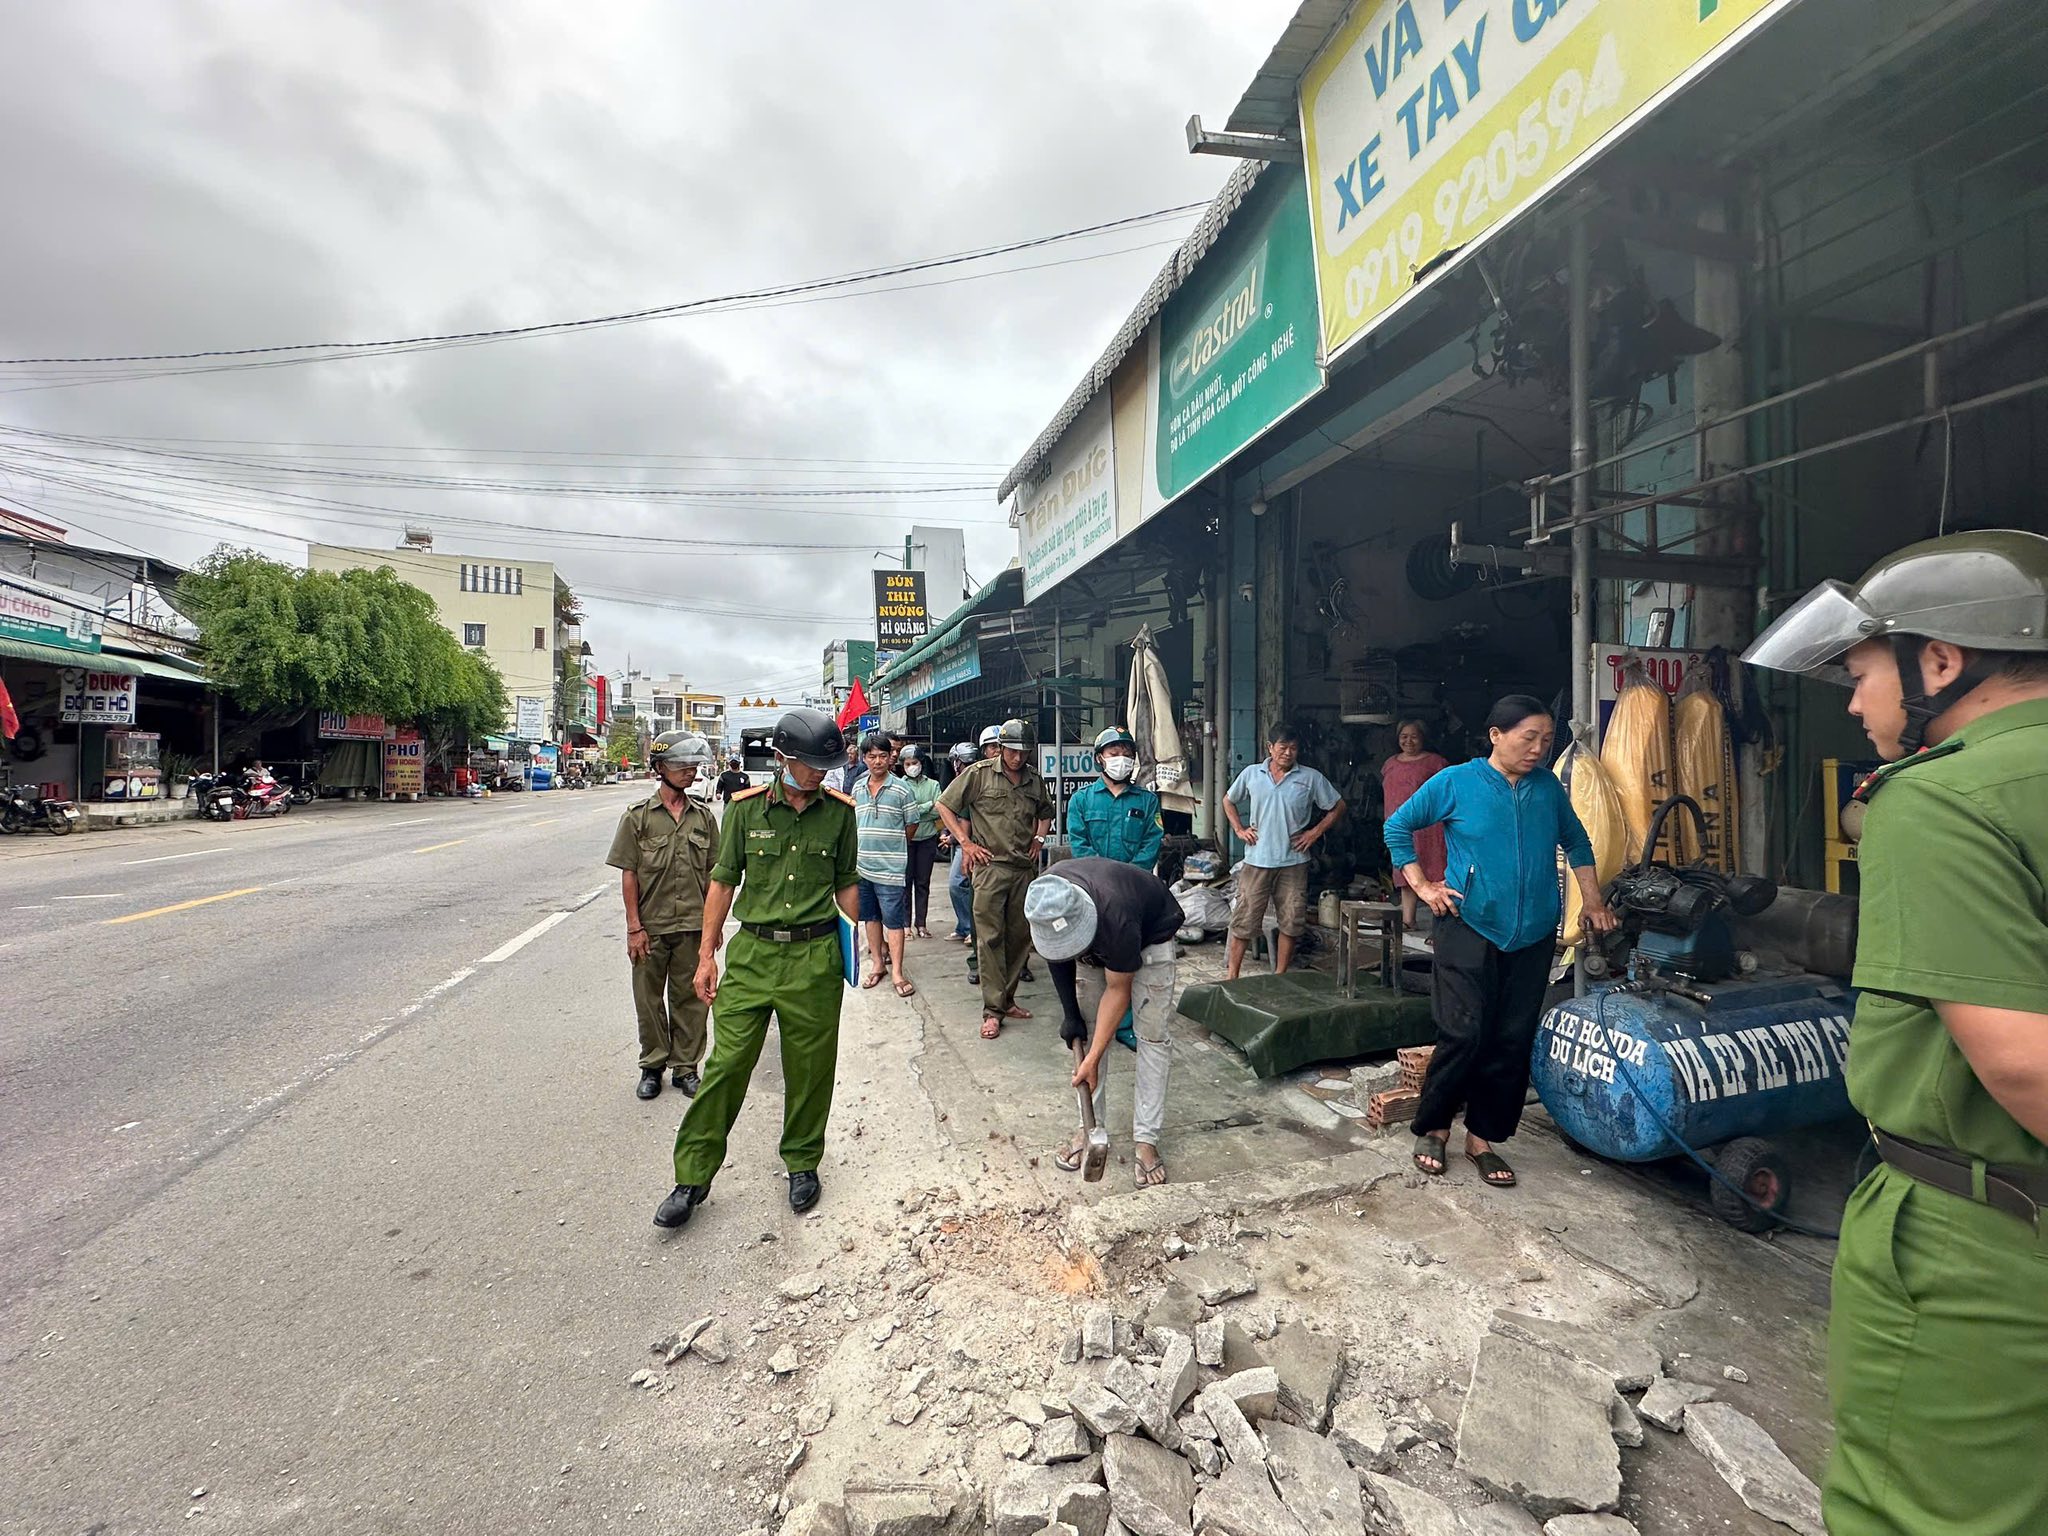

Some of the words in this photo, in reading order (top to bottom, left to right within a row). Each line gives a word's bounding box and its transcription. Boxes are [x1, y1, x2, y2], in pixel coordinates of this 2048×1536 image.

[1334, 133, 1385, 232] XE
[1396, 13, 1488, 161] TAY
[1345, 211, 1422, 320] 0919
[1434, 33, 1624, 245] 920594
[1192, 264, 1256, 376] Castrol
[1187, 413, 1201, 440] TINH
[1202, 402, 1215, 427] HOA
[1216, 388, 1230, 413] CỦA
[1231, 372, 1247, 401] MỘT
[1247, 352, 1268, 384] CÔNG
[1271, 323, 1295, 363] NGHỆ
[886, 574, 914, 587] BÚN
[886, 591, 916, 605] THỊT
[879, 603, 925, 617] NƯỚNG
[880, 619, 893, 635] MÌ
[894, 617, 925, 636] QUẢNG
[386, 741, 420, 757] PHỞ
[1550, 1034, 1572, 1065] DU
[1572, 1044, 1617, 1084] LỊCH
[1555, 1010, 1580, 1039] XE
[1578, 1019, 1648, 1067] HONDA
[1734, 1027, 1789, 1091] XE
[1769, 1019, 1831, 1084] TAY
